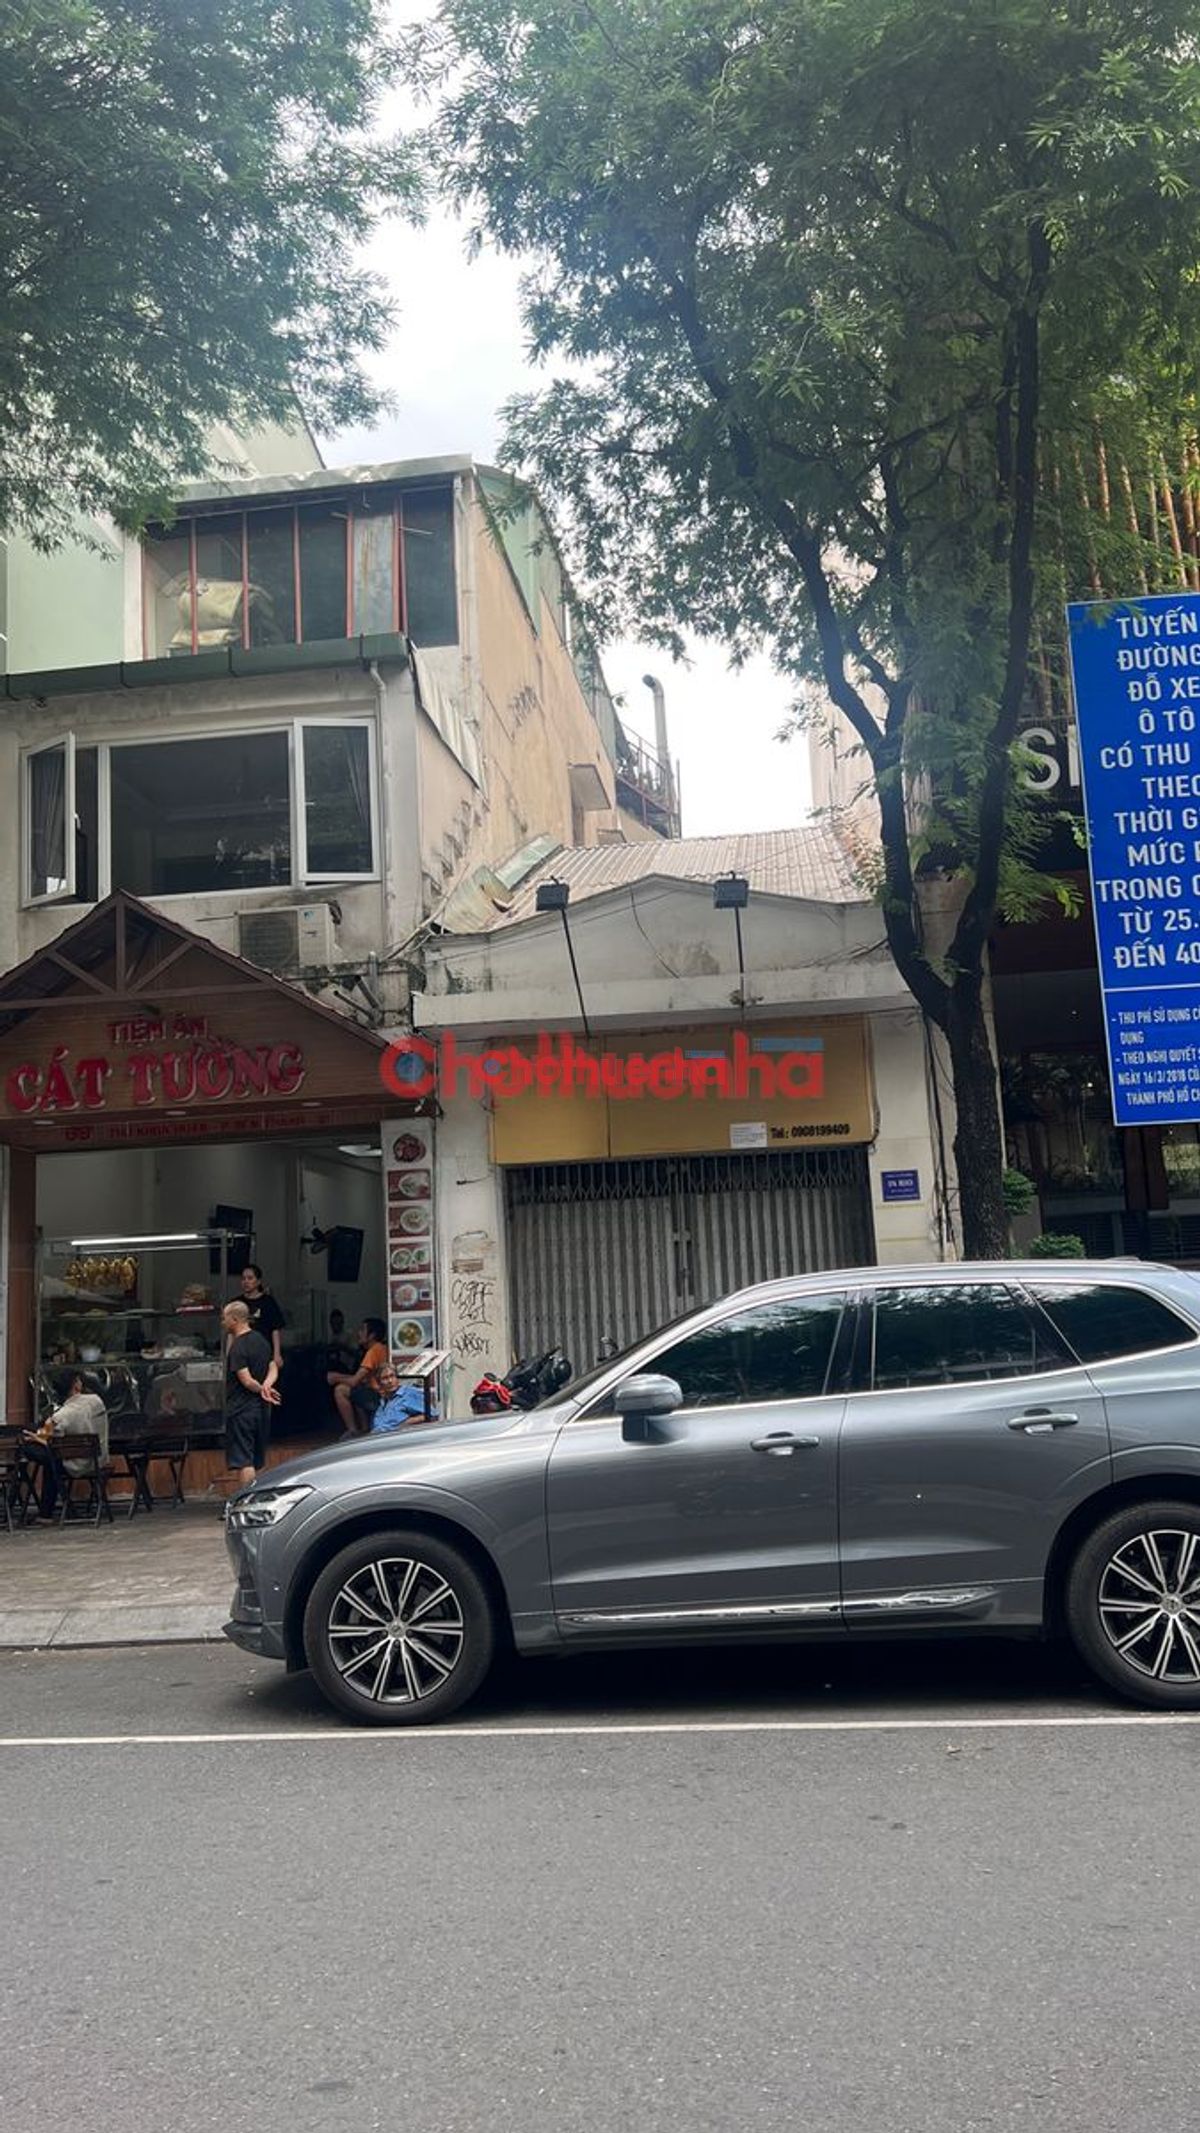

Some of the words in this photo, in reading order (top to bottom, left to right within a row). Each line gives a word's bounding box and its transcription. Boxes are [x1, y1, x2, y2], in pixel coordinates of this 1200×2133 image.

[1116, 606, 1198, 639] TUYẾN
[1116, 642, 1200, 671] ĐƯỜNG
[1127, 672, 1162, 702] ĐỖ
[1170, 676, 1200, 700] XE
[1138, 708, 1155, 734] Ô
[1162, 705, 1195, 732] TÔ
[1100, 740, 1134, 769] CÓ
[1140, 742, 1190, 766] THU
[1113, 804, 1173, 835] THỜI
[1127, 837, 1186, 867] MỨC
[1096, 875, 1182, 902] TRONG
[1118, 905, 1153, 935] TỪ
[1163, 908, 1200, 932] 25.
[1113, 937, 1167, 969] ĐẾN
[1118, 1011, 1136, 1025] THU
[1137, 1006, 1152, 1023] PHÍ
[1122, 1050, 1145, 1065] THEO
[6, 1044, 112, 1112] CÁT
[127, 1034, 305, 1105] TƯỜNG
